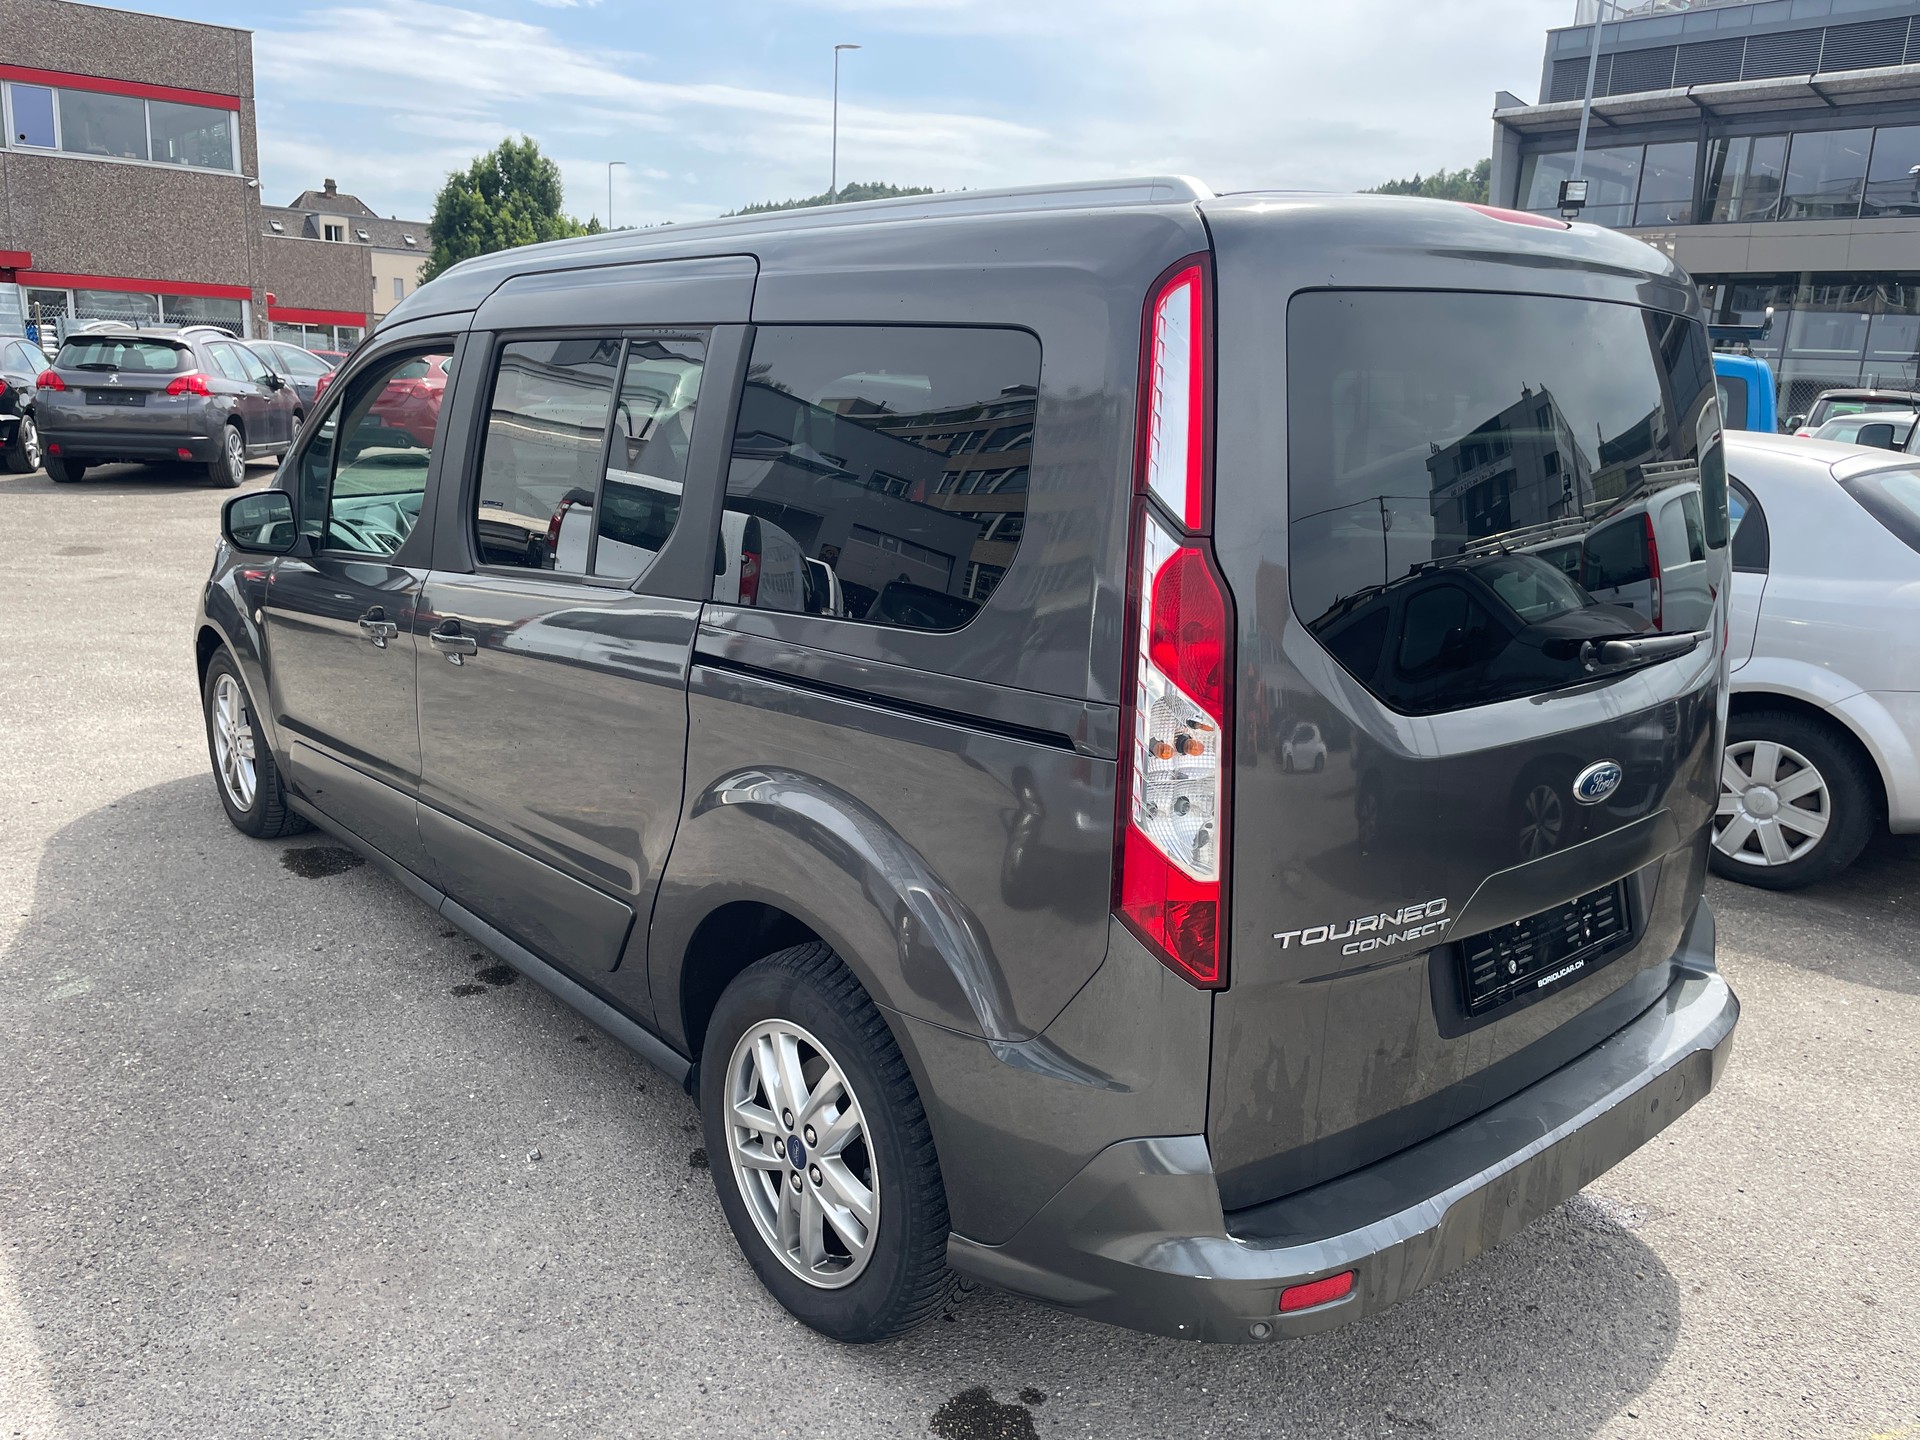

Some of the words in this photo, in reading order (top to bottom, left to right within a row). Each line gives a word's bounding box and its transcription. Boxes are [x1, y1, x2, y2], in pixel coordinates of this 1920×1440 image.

[1590, 769, 1618, 795] Ford
[1273, 898, 1448, 949] TOURNEO
[1341, 918, 1450, 956] CONNECT
